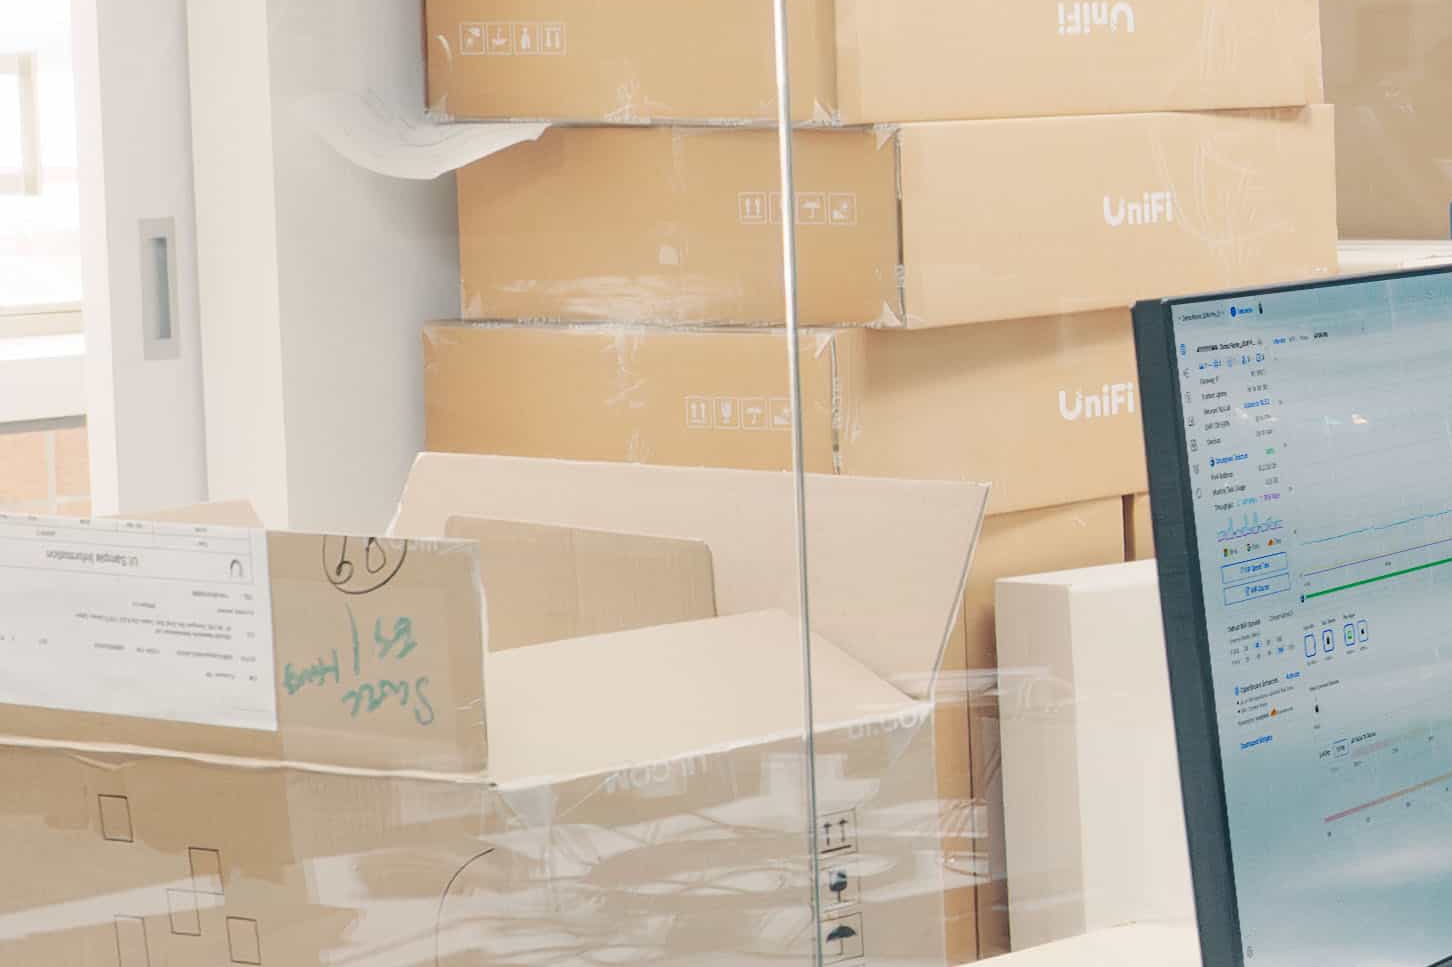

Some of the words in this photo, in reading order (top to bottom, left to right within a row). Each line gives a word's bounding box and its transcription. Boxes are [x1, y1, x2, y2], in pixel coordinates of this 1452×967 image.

[1057, 1, 1135, 36] UniFi
[1103, 192, 1174, 227] UniFi
[1058, 382, 1135, 422] UniFi
[46, 549, 94, 564] Information
